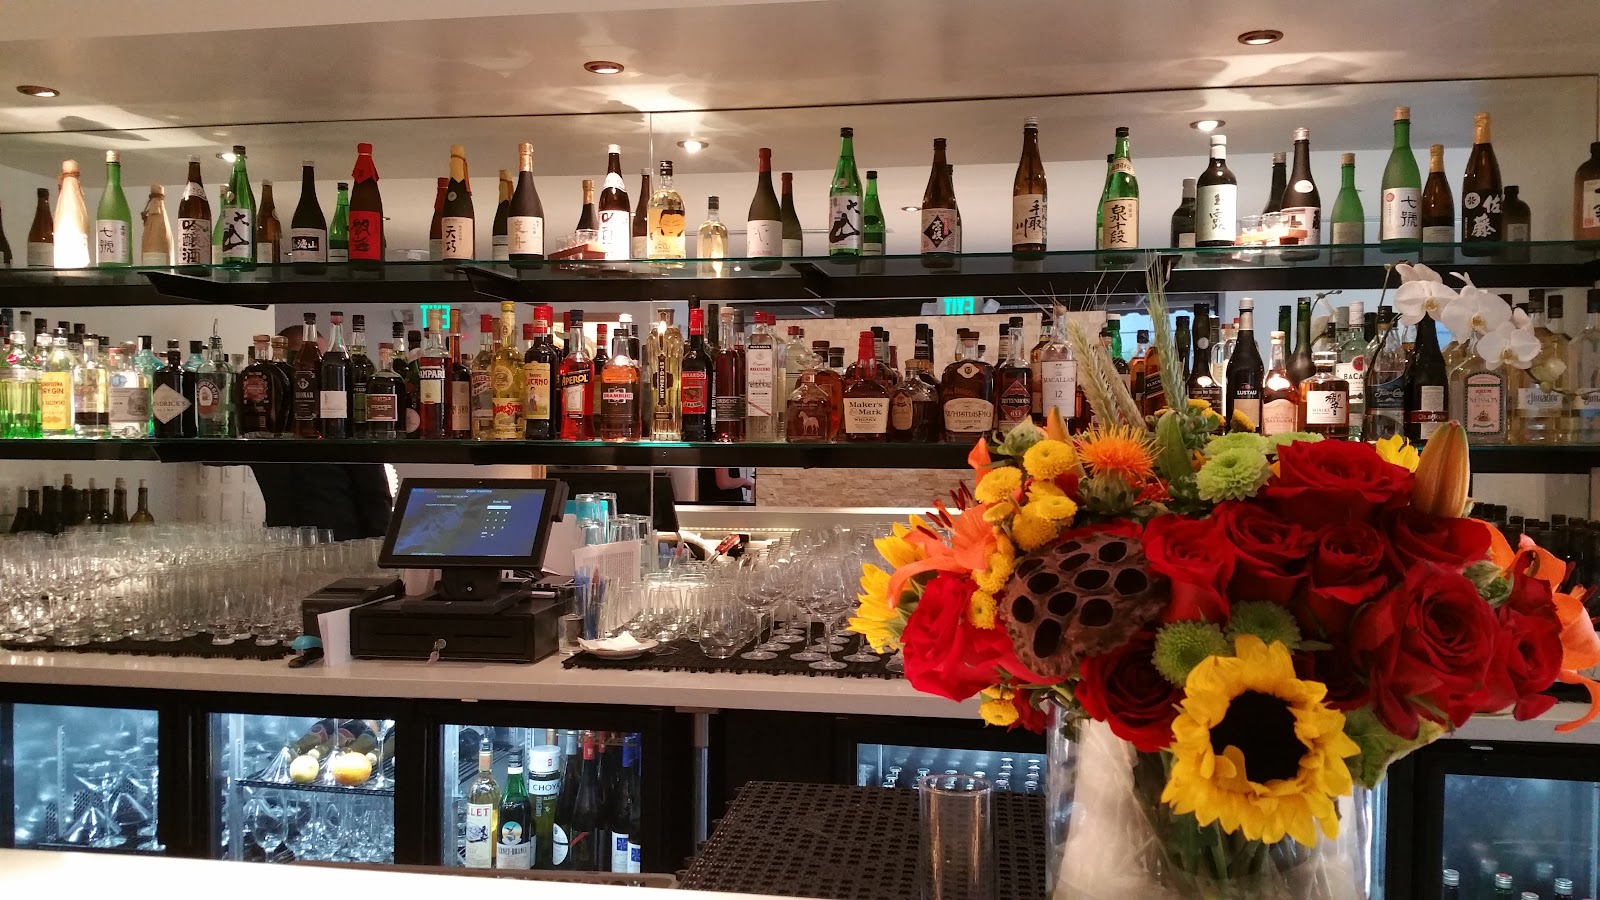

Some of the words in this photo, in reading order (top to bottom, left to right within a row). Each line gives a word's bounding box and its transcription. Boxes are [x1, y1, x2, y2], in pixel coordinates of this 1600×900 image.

[419, 369, 445, 379] AMPARI
[1343, 372, 1364, 380] BACA
[467, 807, 490, 817] LET
